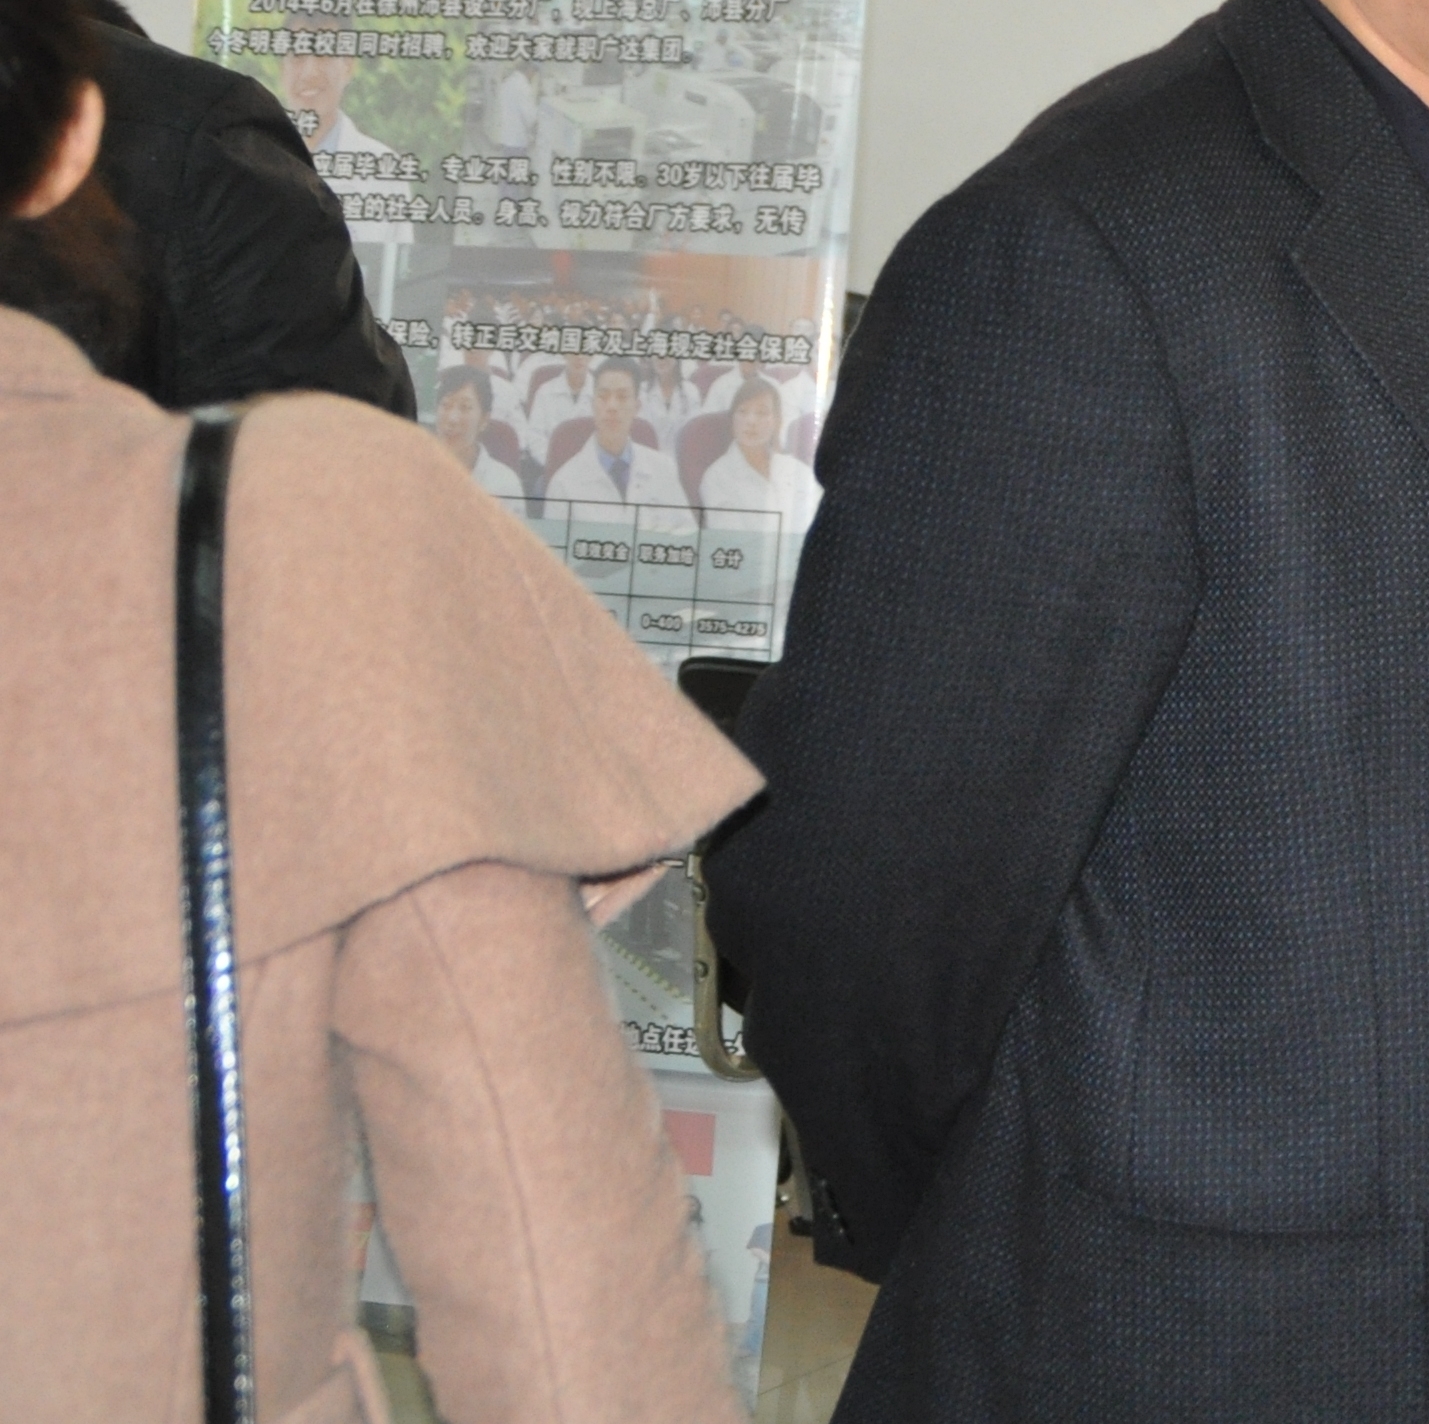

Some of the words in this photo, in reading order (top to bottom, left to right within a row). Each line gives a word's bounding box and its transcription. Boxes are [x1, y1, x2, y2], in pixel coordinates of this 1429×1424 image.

[337, 192, 807, 235] 验的社会人员。身高、视力符合厂方要求，无传
[377, 318, 813, 364] 保险，转正后交纳国家及上海规定社会保险
[711, 547, 744, 570] 合计
